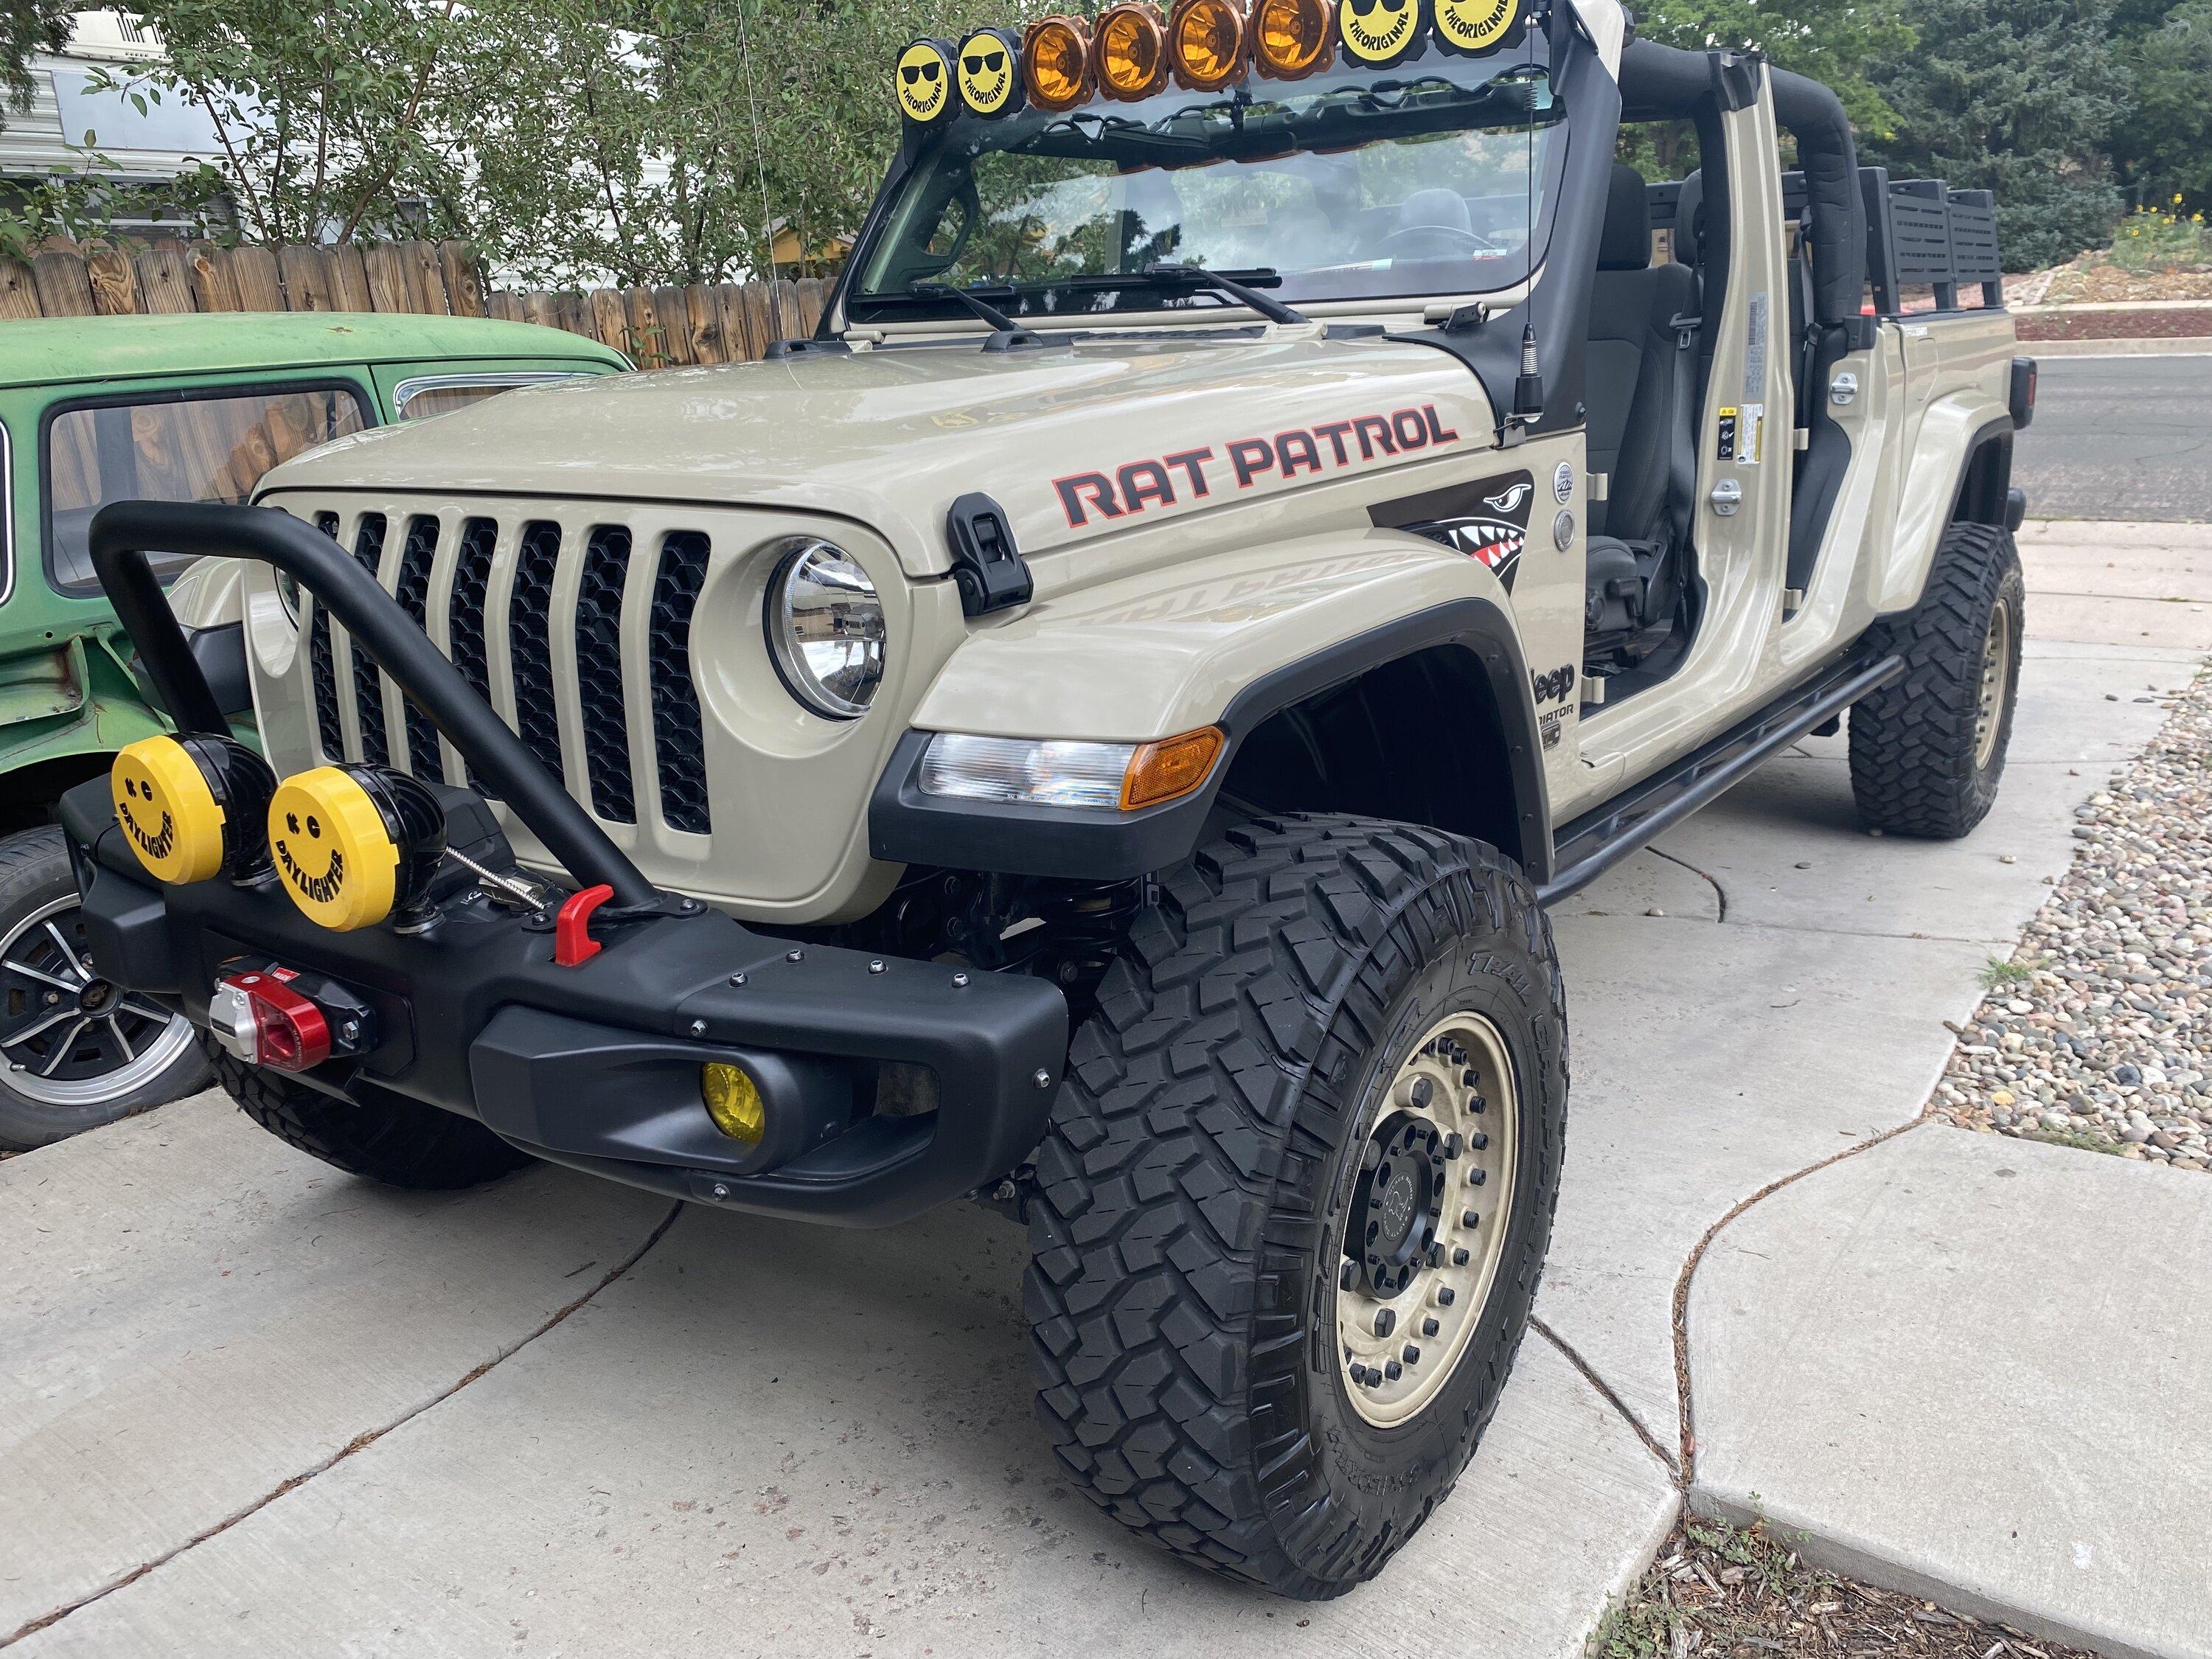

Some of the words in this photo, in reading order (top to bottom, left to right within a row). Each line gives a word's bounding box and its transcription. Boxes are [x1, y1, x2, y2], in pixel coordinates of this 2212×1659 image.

[1051, 446, 1215, 529] RAT
[1224, 403, 1461, 489] PATROL
[119, 802, 174, 860] DAYLIGHTER
[275, 840, 344, 903] DAYLIGHTER
